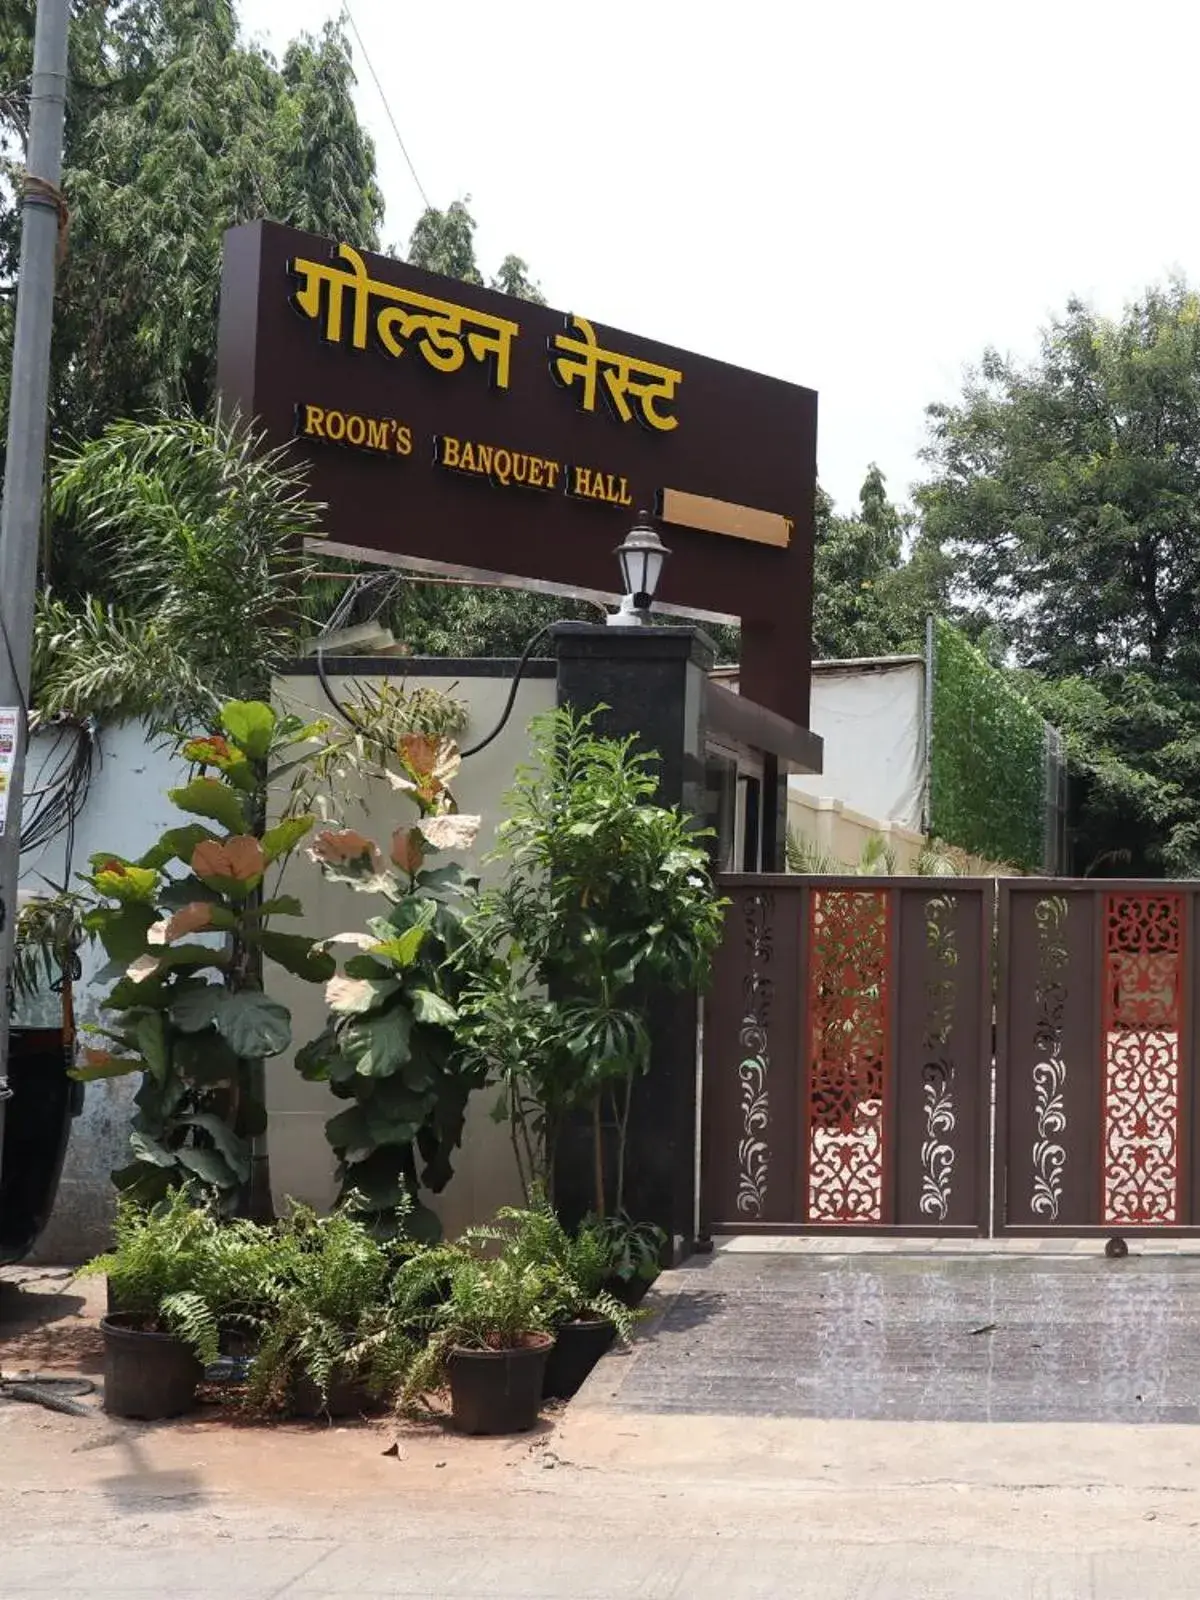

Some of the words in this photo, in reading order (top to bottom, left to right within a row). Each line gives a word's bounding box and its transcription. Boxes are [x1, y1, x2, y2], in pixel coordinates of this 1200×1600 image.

[294, 242, 520, 389] गोल्डन
[554, 313, 682, 432] नेस्ट
[304, 404, 412, 455] ROOM'S
[442, 436, 559, 488] BANQUET
[574, 466, 632, 505] HALL
